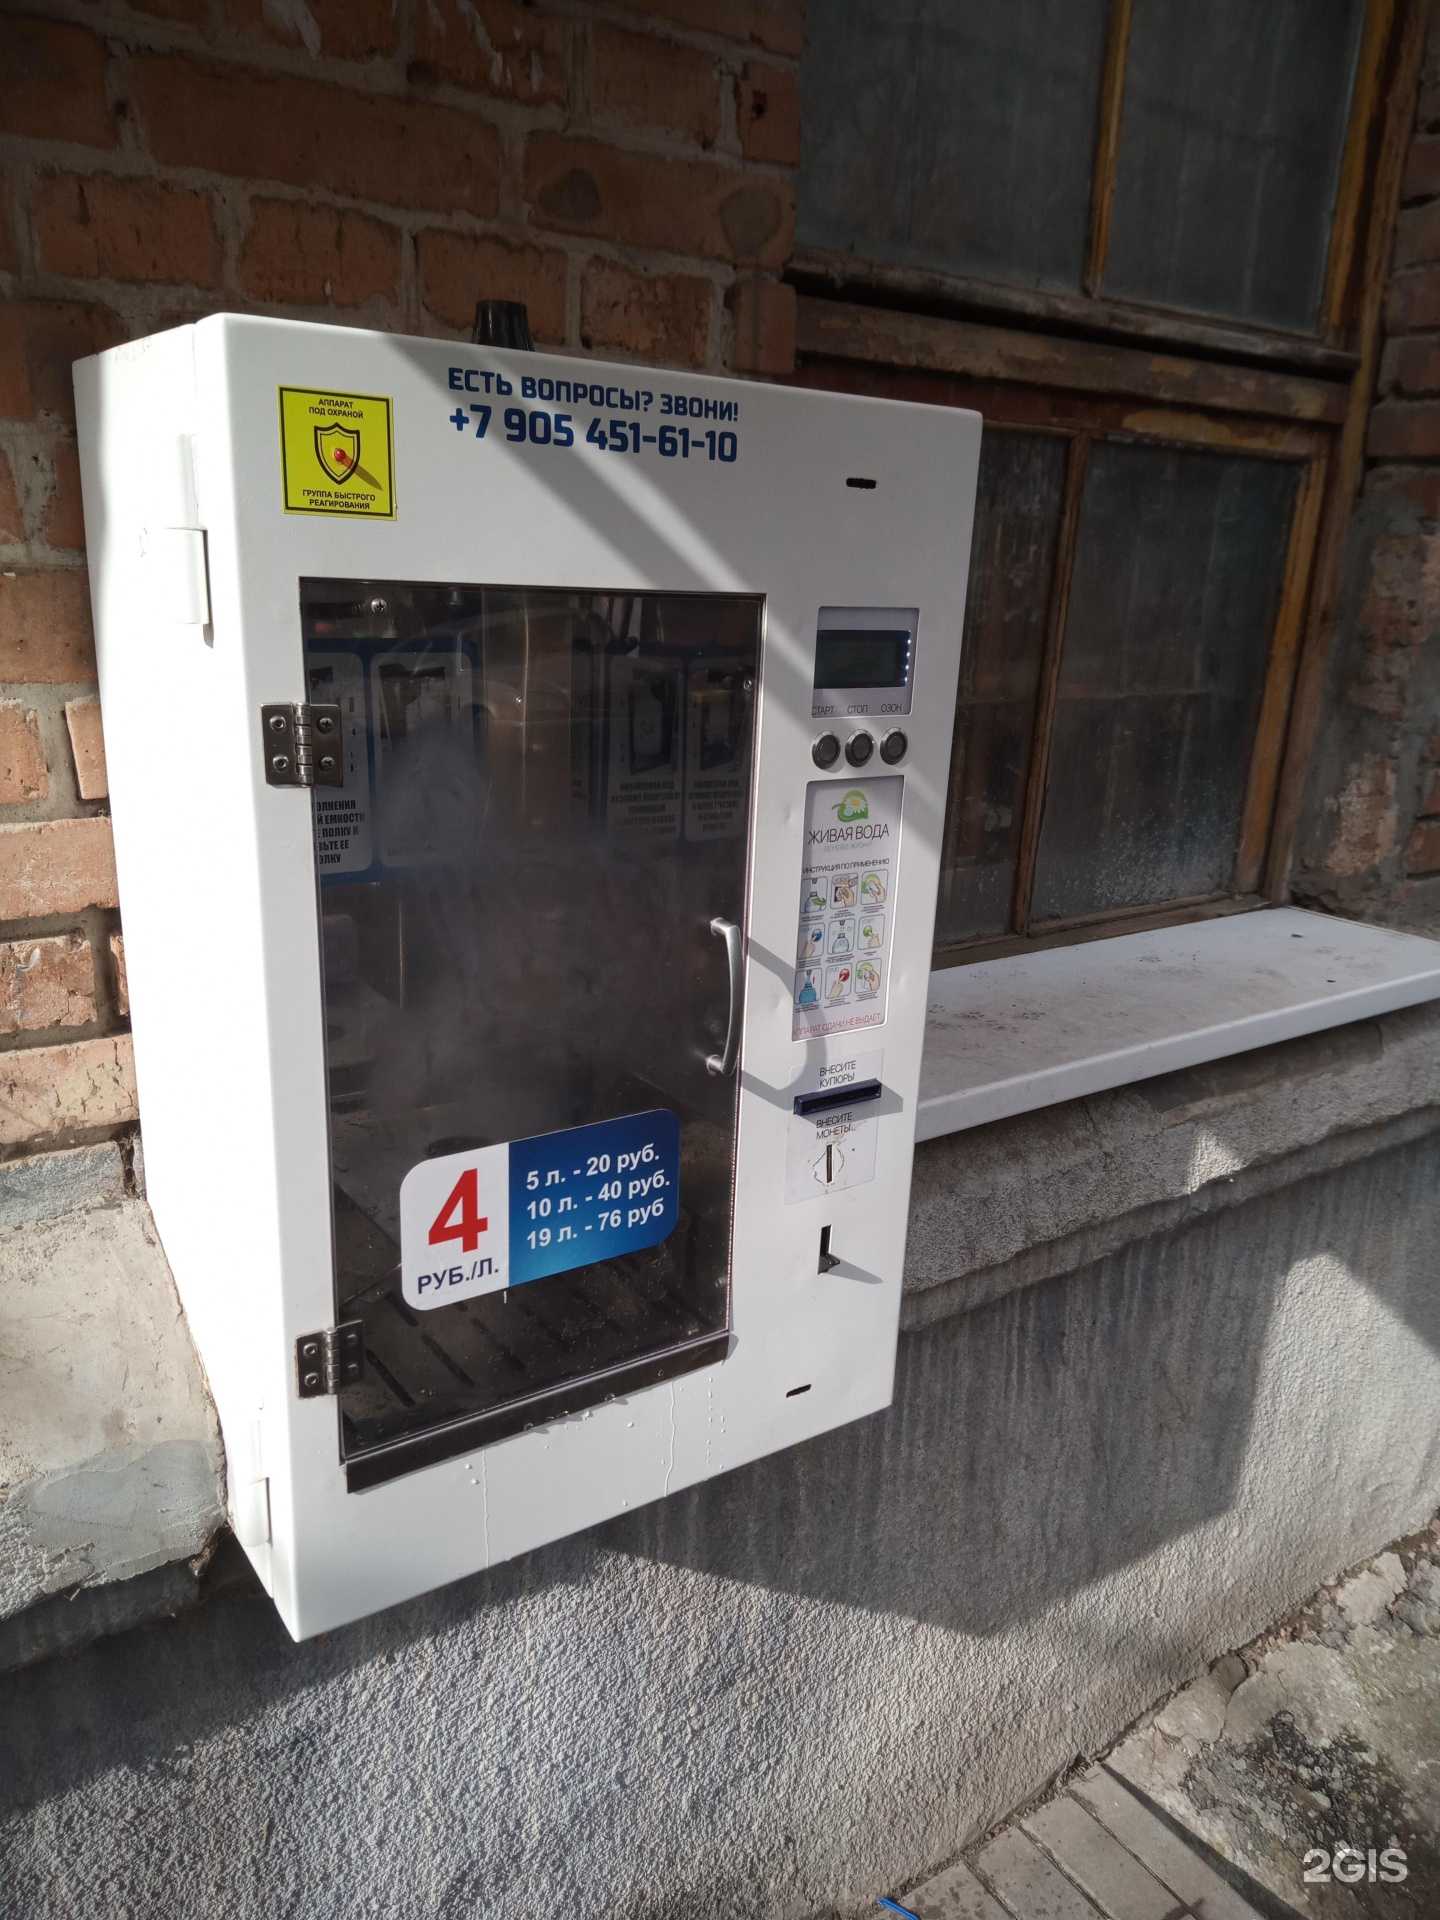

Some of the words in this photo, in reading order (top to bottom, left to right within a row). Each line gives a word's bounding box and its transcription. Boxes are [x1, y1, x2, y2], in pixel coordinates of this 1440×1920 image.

[448, 367, 512, 396] ЕСТЬ
[521, 376, 653, 412] ВОПРОСЫ?
[660, 393, 738, 421] ЗВОНИ!
[319, 398, 354, 409] АППАРАТ
[309, 406, 326, 416] ПОД
[328, 408, 364, 419] ОХРАНОЙ
[450, 404, 492, 438] +7
[504, 408, 574, 447] 905
[586, 417, 738, 462] 451-61-10
[303, 489, 332, 499] ГРУППА
[334, 492, 376, 502] БЫСТРОГО
[309, 498, 370, 510] РЕАГИРОВАНИЯ
[847, 703, 869, 713] СТОП
[880, 703, 902, 713] ОЗОН
[322, 826, 351, 838] ПОЛКУ
[808, 826, 853, 845] ЖИВАЯ
[855, 824, 889, 841] ВОДА
[819, 1060, 856, 1077] ВНЕСИТЕ
[819, 1073, 855, 1088] КУПЮРЫ
[816, 1112, 853, 1128] ВНЕСИТЕ
[526, 1170, 540, 1190] 5
[545, 1174, 565, 1187] л.
[586, 1154, 611, 1177] 20
[617, 1143, 660, 1173] руб.
[527, 1200, 551, 1220] 10
[557, 1200, 578, 1214] л.
[598, 1180, 622, 1202] 40
[628, 1170, 670, 1196] руб.
[428, 1168, 488, 1253] 4
[527, 1230, 551, 1250] 19
[557, 1228, 578, 1243] л.
[598, 1210, 622, 1232] 76
[628, 1198, 664, 1227] руб
[418, 1258, 499, 1294] РУБ./Л.
